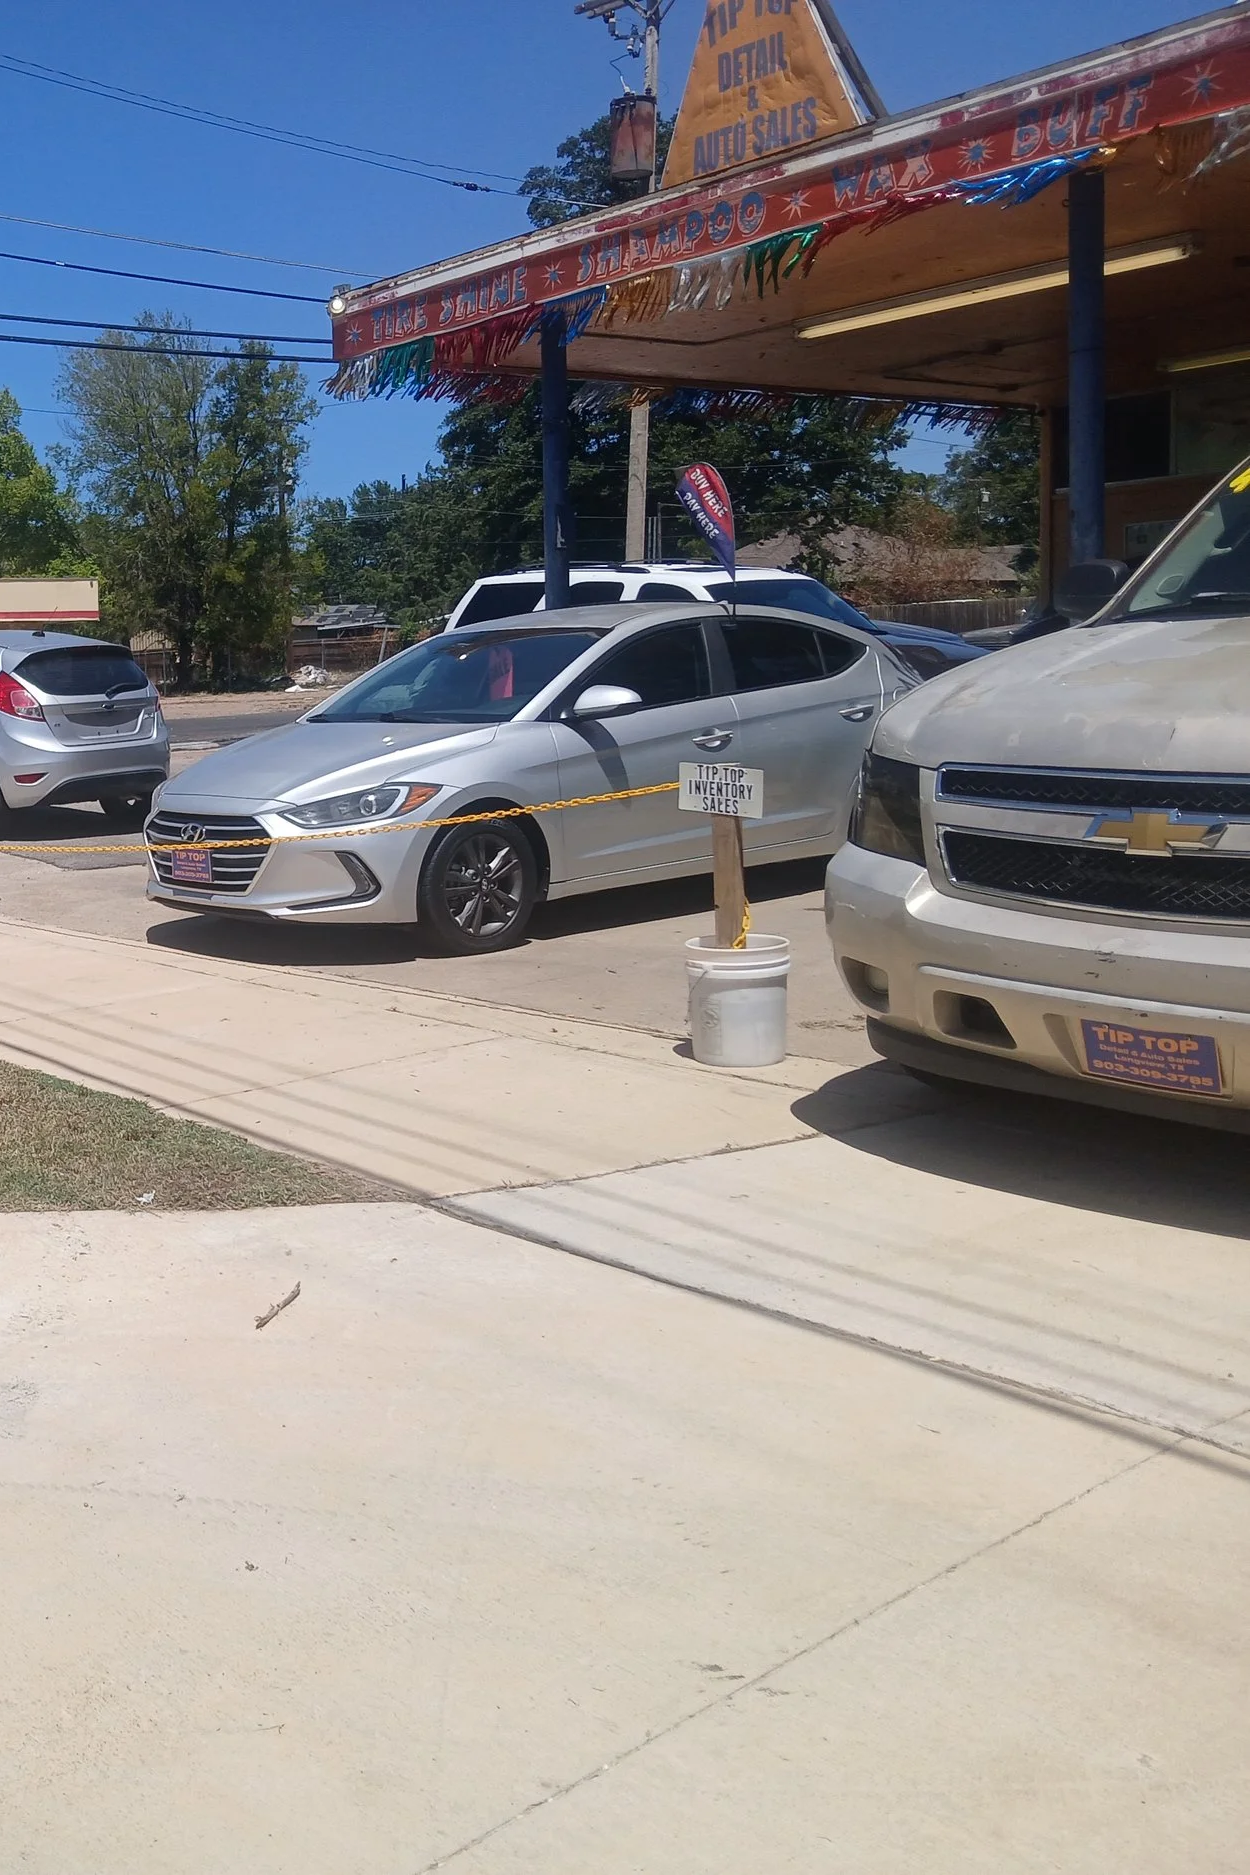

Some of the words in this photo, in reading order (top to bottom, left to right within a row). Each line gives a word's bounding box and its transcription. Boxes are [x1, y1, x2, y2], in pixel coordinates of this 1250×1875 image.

[718, 32, 787, 92] DETAIL
[747, 85, 759, 111] &
[693, 119, 746, 176] AUTO
[752, 96, 817, 156] SALES
[370, 295, 428, 344] TIRE
[440, 266, 529, 327] SHINE
[576, 190, 767, 287] SHAMPOO
[831, 138, 935, 208] WAX
[1011, 73, 1156, 162] BUFF
[690, 468, 710, 490] BUY
[703, 490, 728, 518] HERE
[683, 492, 701, 511] PAY
[696, 511, 720, 539] HERE
[689, 779, 753, 800] INVENTORY
[702, 796, 739, 814] SALES
[175, 851, 187, 860] TIP
[187, 852, 205, 861] TOP
[1091, 1026, 1134, 1044] TIP
[1139, 1036, 1199, 1054] TOP
[1099, 1043, 1129, 1055] Detail
[1141, 1051, 1165, 1062] Auto
[1167, 1055, 1200, 1066] Sales
